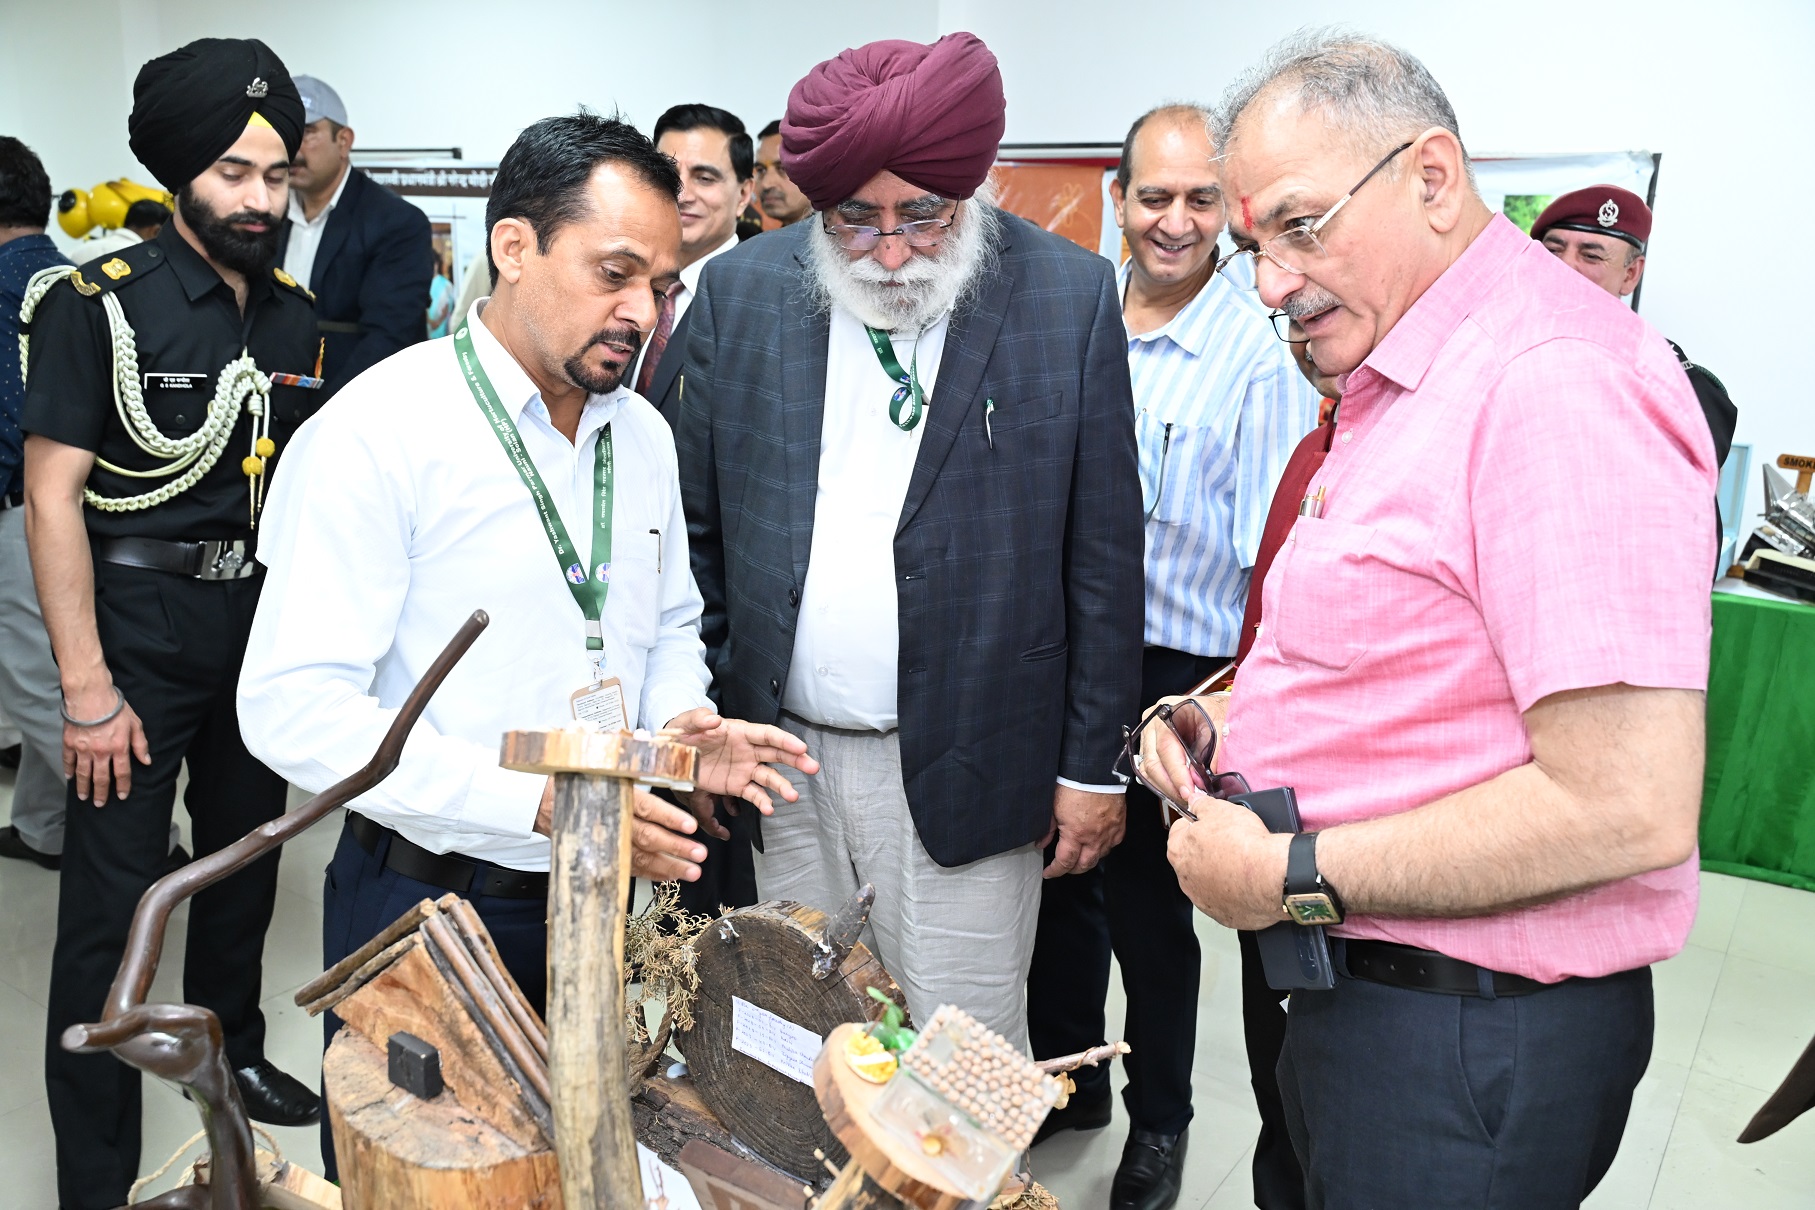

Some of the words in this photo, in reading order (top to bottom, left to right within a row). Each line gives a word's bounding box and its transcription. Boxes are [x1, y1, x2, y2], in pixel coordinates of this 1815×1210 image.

[496, 424, 505, 432] of
[503, 432, 522, 466] University
[521, 466, 537, 490] Parmar
[536, 490, 546, 510] Singh
[543, 510, 559, 544] Yashwant
[557, 544, 565, 555] Dr.
